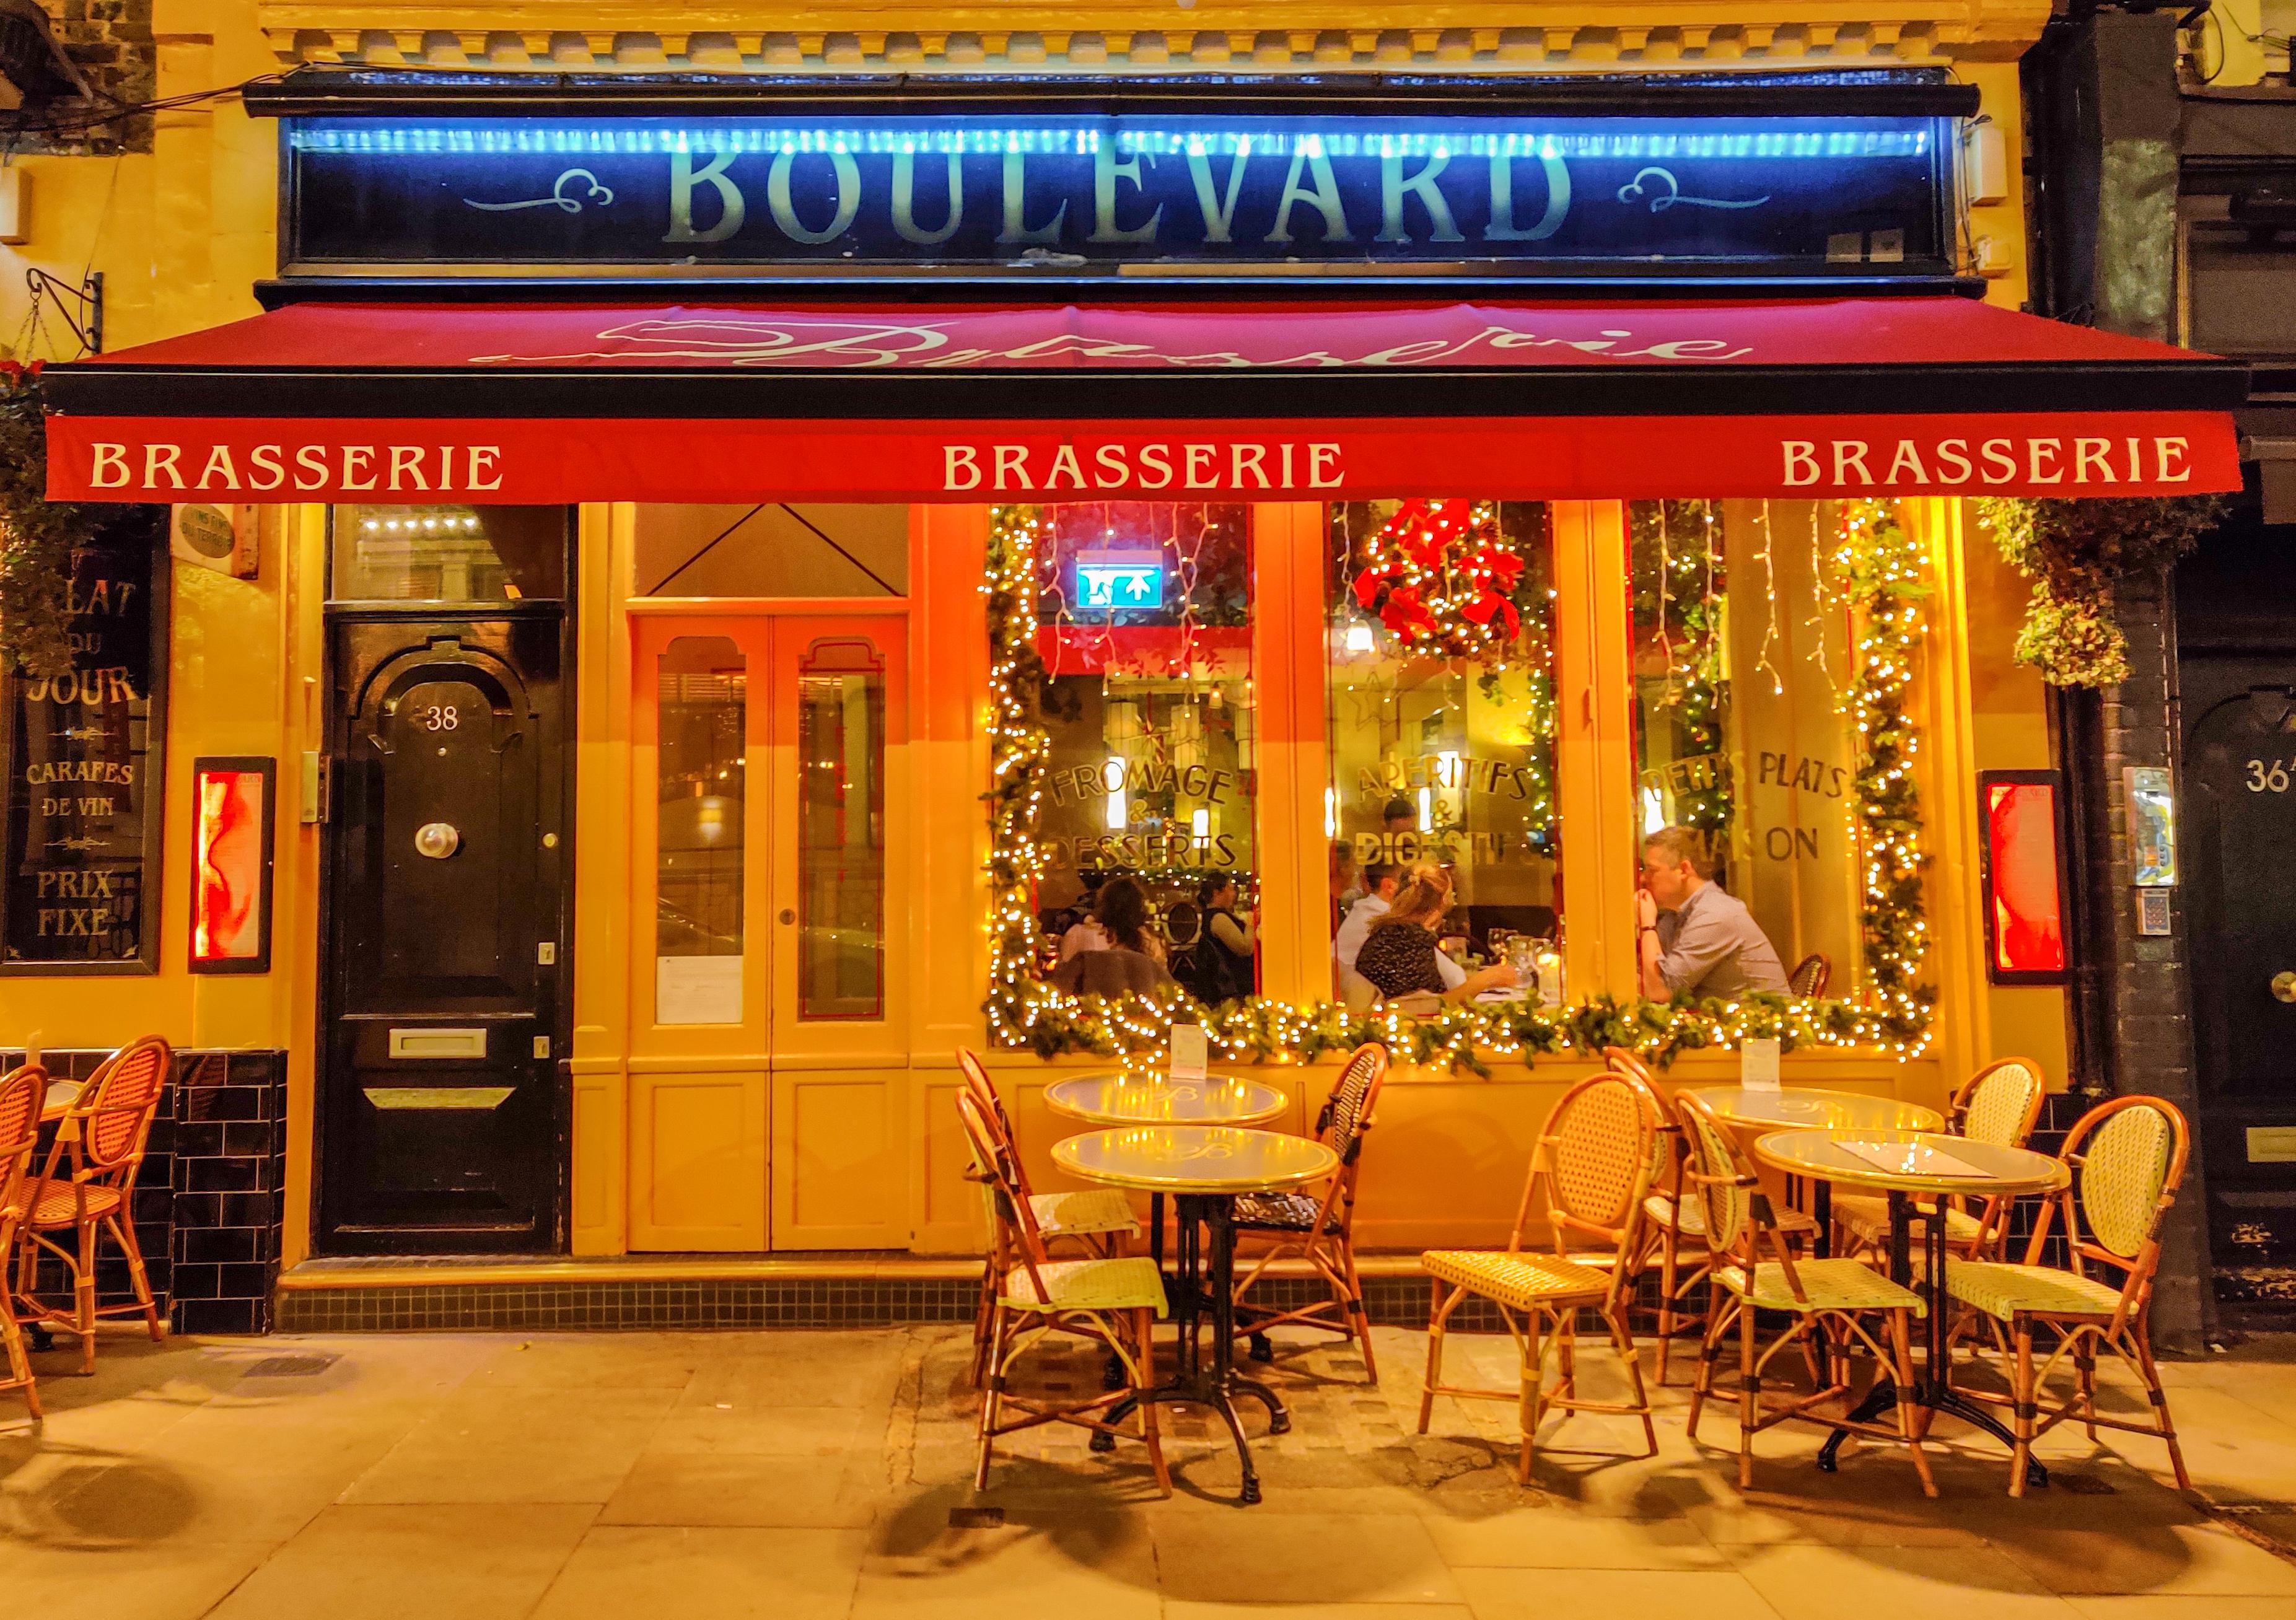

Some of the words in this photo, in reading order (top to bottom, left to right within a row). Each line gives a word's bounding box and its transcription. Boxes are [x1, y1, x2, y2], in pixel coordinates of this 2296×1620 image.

[661, 130, 1571, 244] BOULEVARD
[89, 442, 504, 491] BRASSERIE
[942, 442, 1346, 491] BRASSERIE
[1781, 436, 2191, 487] BRASSERIE
[60, 579, 136, 616] LAT
[27, 666, 137, 705] JOUR
[426, 706, 458, 731] 38
[26, 761, 134, 785] CARAFES
[1051, 758, 1233, 807] FROMAGE
[1759, 751, 1848, 799] PLATS
[42, 797, 71, 816] DE
[77, 797, 114, 816] VIN
[1129, 799, 1150, 826] &
[1053, 833, 1237, 869] DESSERTS
[37, 869, 114, 898] PRIX
[37, 908, 110, 936] FIXE
